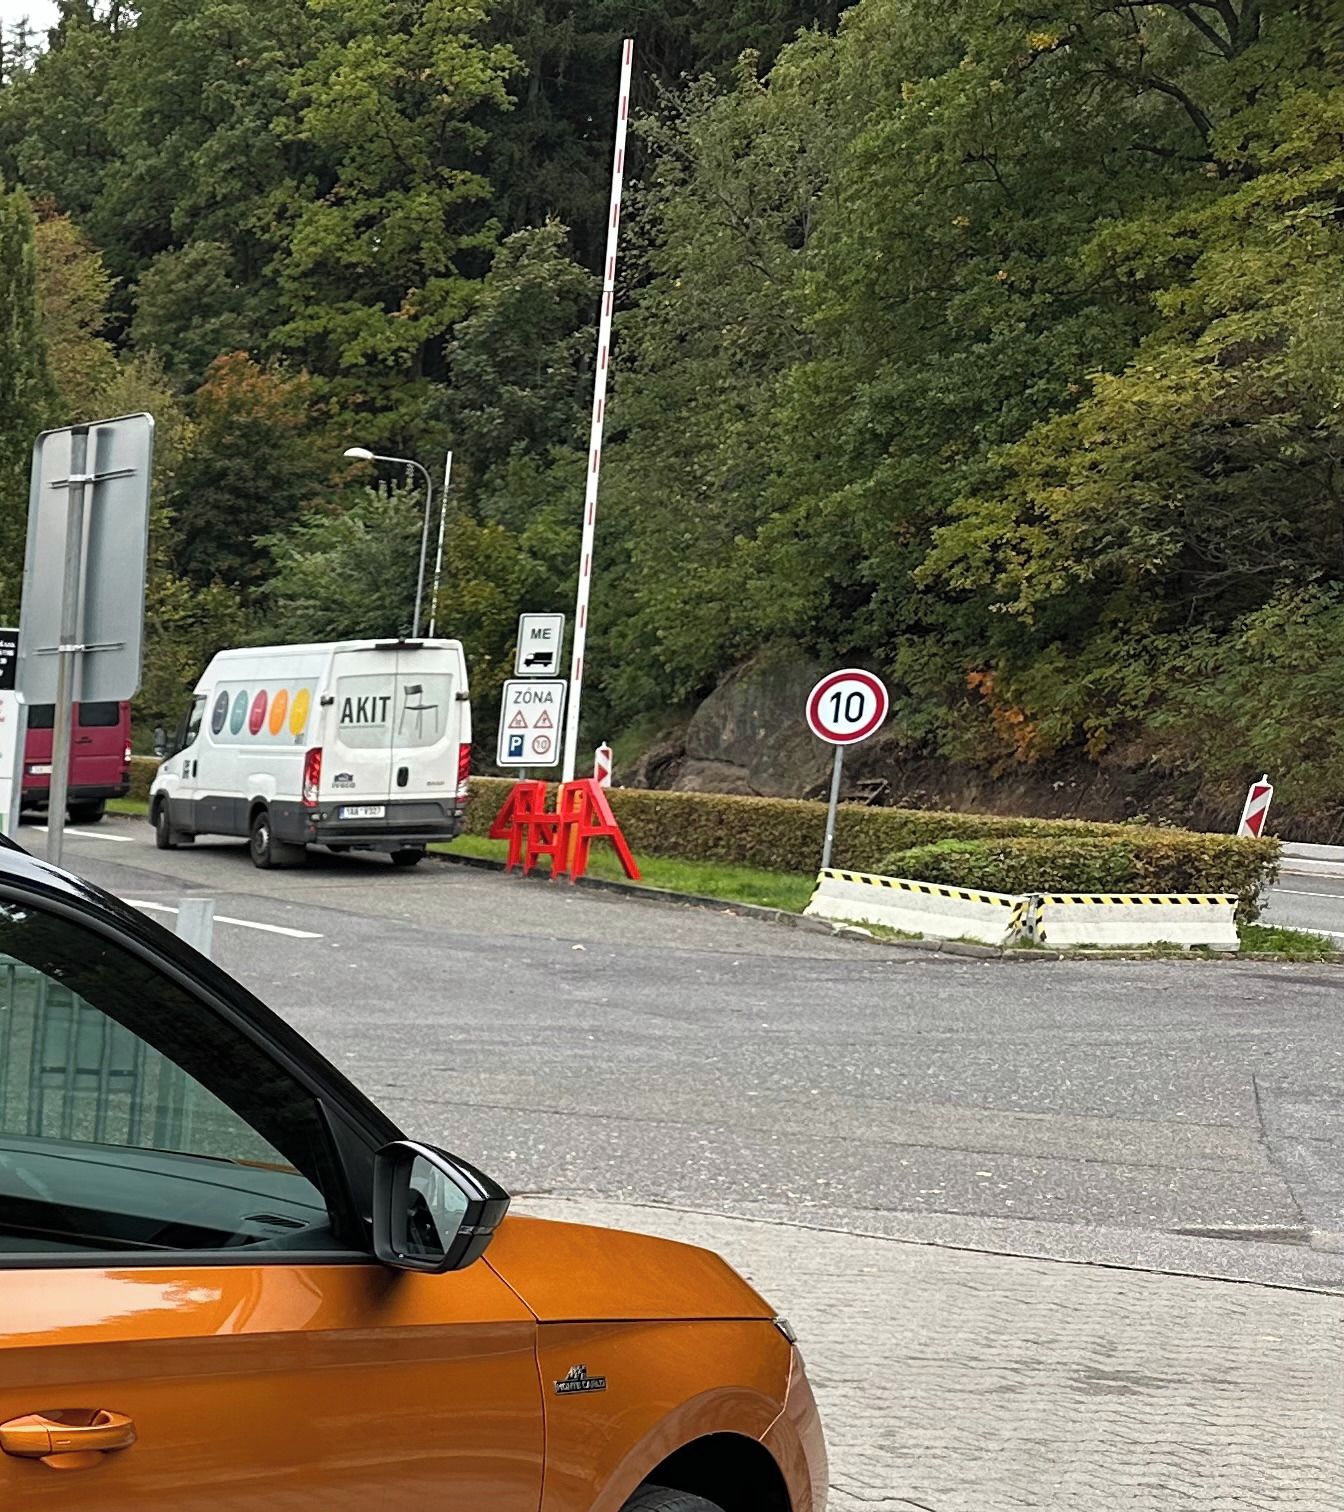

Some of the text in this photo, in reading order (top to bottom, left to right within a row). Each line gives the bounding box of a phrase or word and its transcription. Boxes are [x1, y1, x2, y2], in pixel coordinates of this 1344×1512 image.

[530, 628, 552, 640] ME
[513, 687, 554, 704] ZÓNA
[340, 696, 391, 724] AKIT
[829, 691, 865, 723] 10
